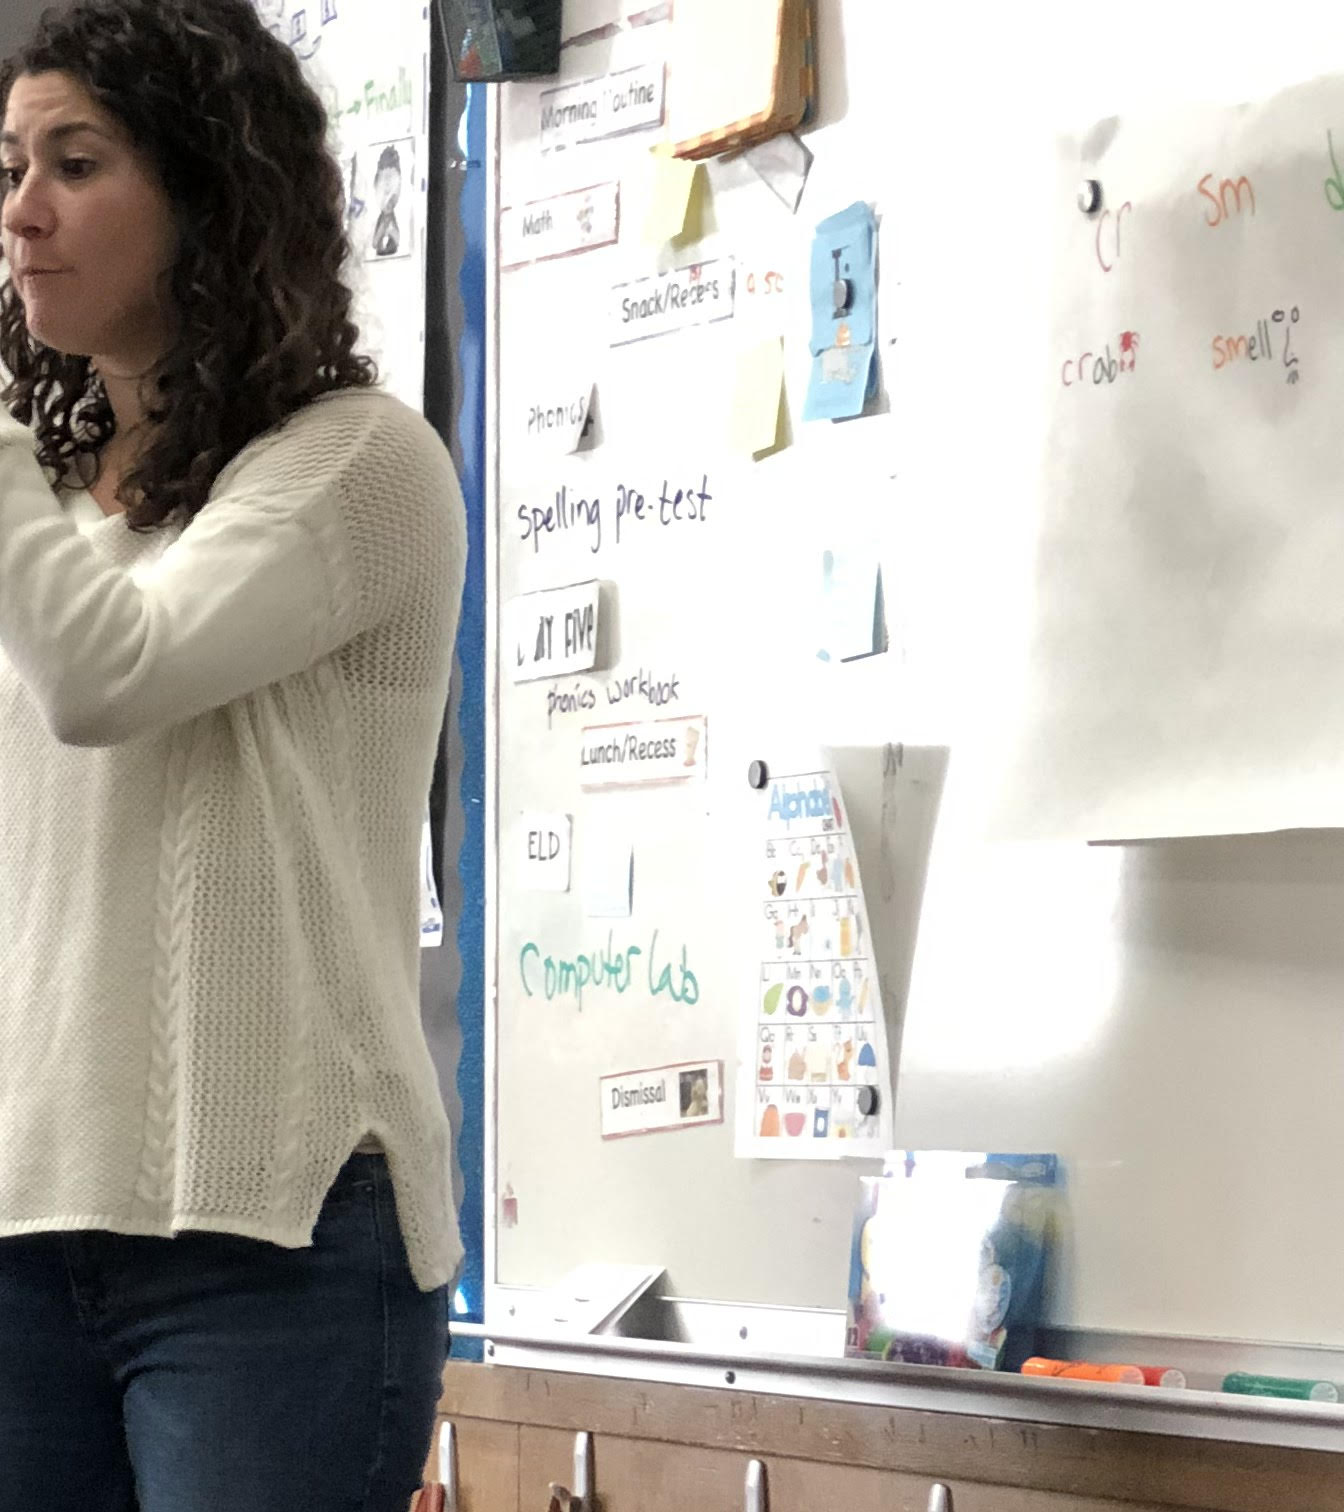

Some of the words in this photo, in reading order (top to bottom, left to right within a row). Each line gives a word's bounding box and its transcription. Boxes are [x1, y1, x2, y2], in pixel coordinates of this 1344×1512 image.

[540, 99, 598, 132] Morning
[604, 80, 655, 114] outine
[522, 210, 554, 238] Math
[1212, 319, 1272, 369] smell
[1062, 344, 1117, 387] crab
[518, 485, 601, 554] spelling
[616, 474, 713, 544] pre-test
[581, 734, 677, 766] Lunch/Recess
[528, 831, 561, 861] ELD
[611, 1078, 666, 1110] Dismissal
